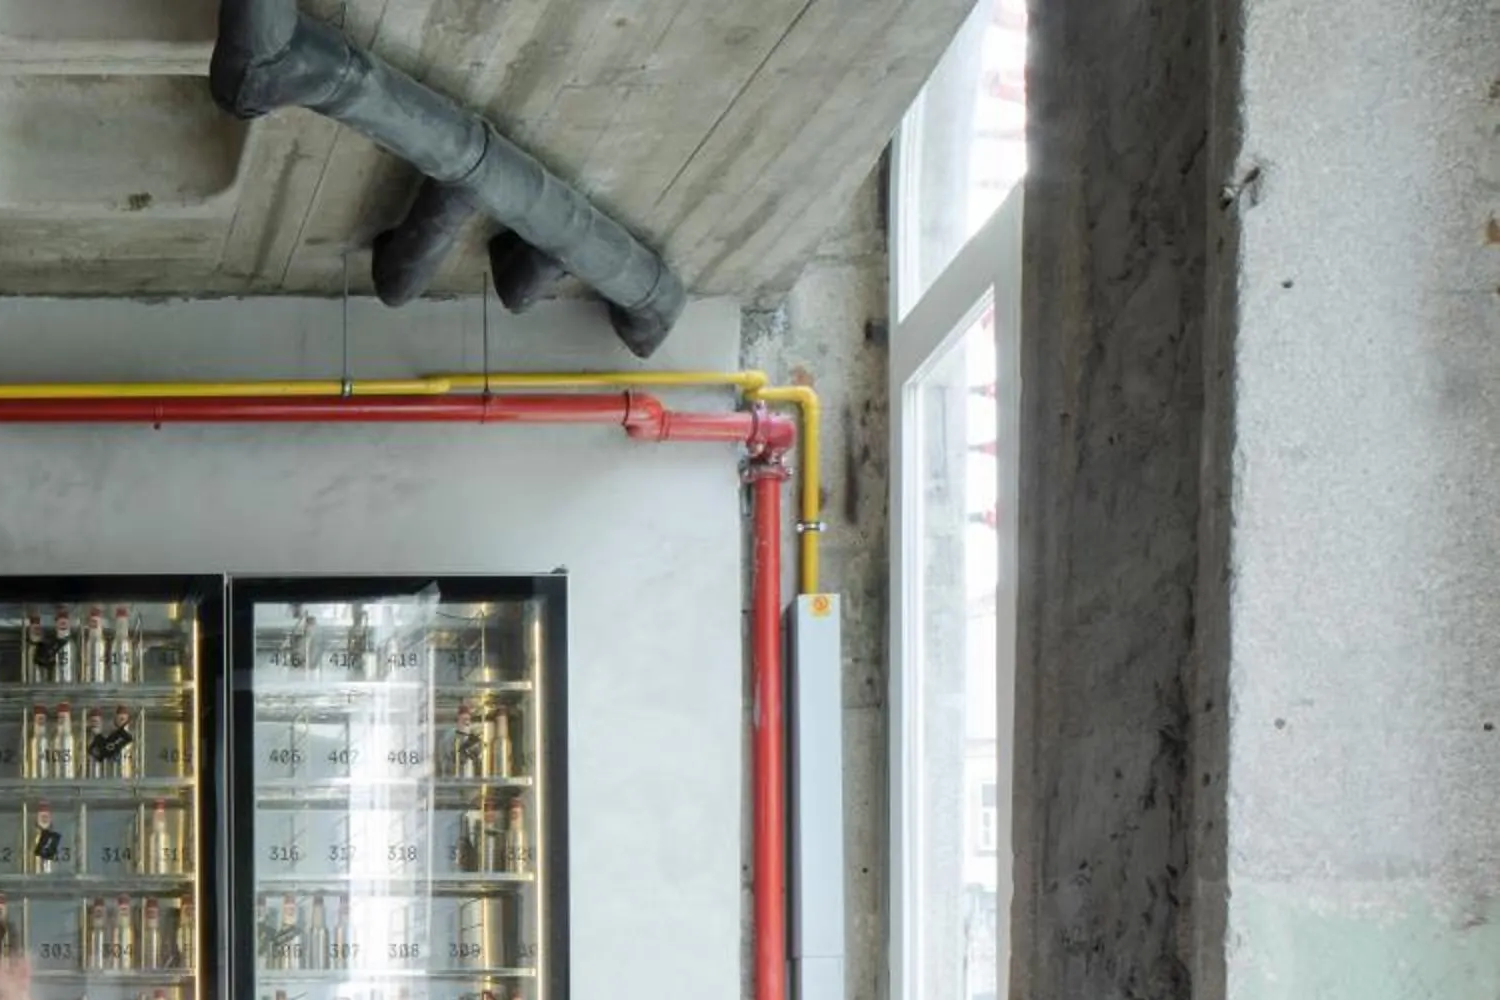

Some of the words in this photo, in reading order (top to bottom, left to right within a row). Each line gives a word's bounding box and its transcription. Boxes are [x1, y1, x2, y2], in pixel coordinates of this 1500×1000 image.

[269, 749, 301, 764] 406
[387, 749, 418, 764] 408
[102, 848, 131, 862] 314
[269, 847, 299, 862] 316
[387, 847, 417, 862] 318
[40, 943, 71, 957] 303
